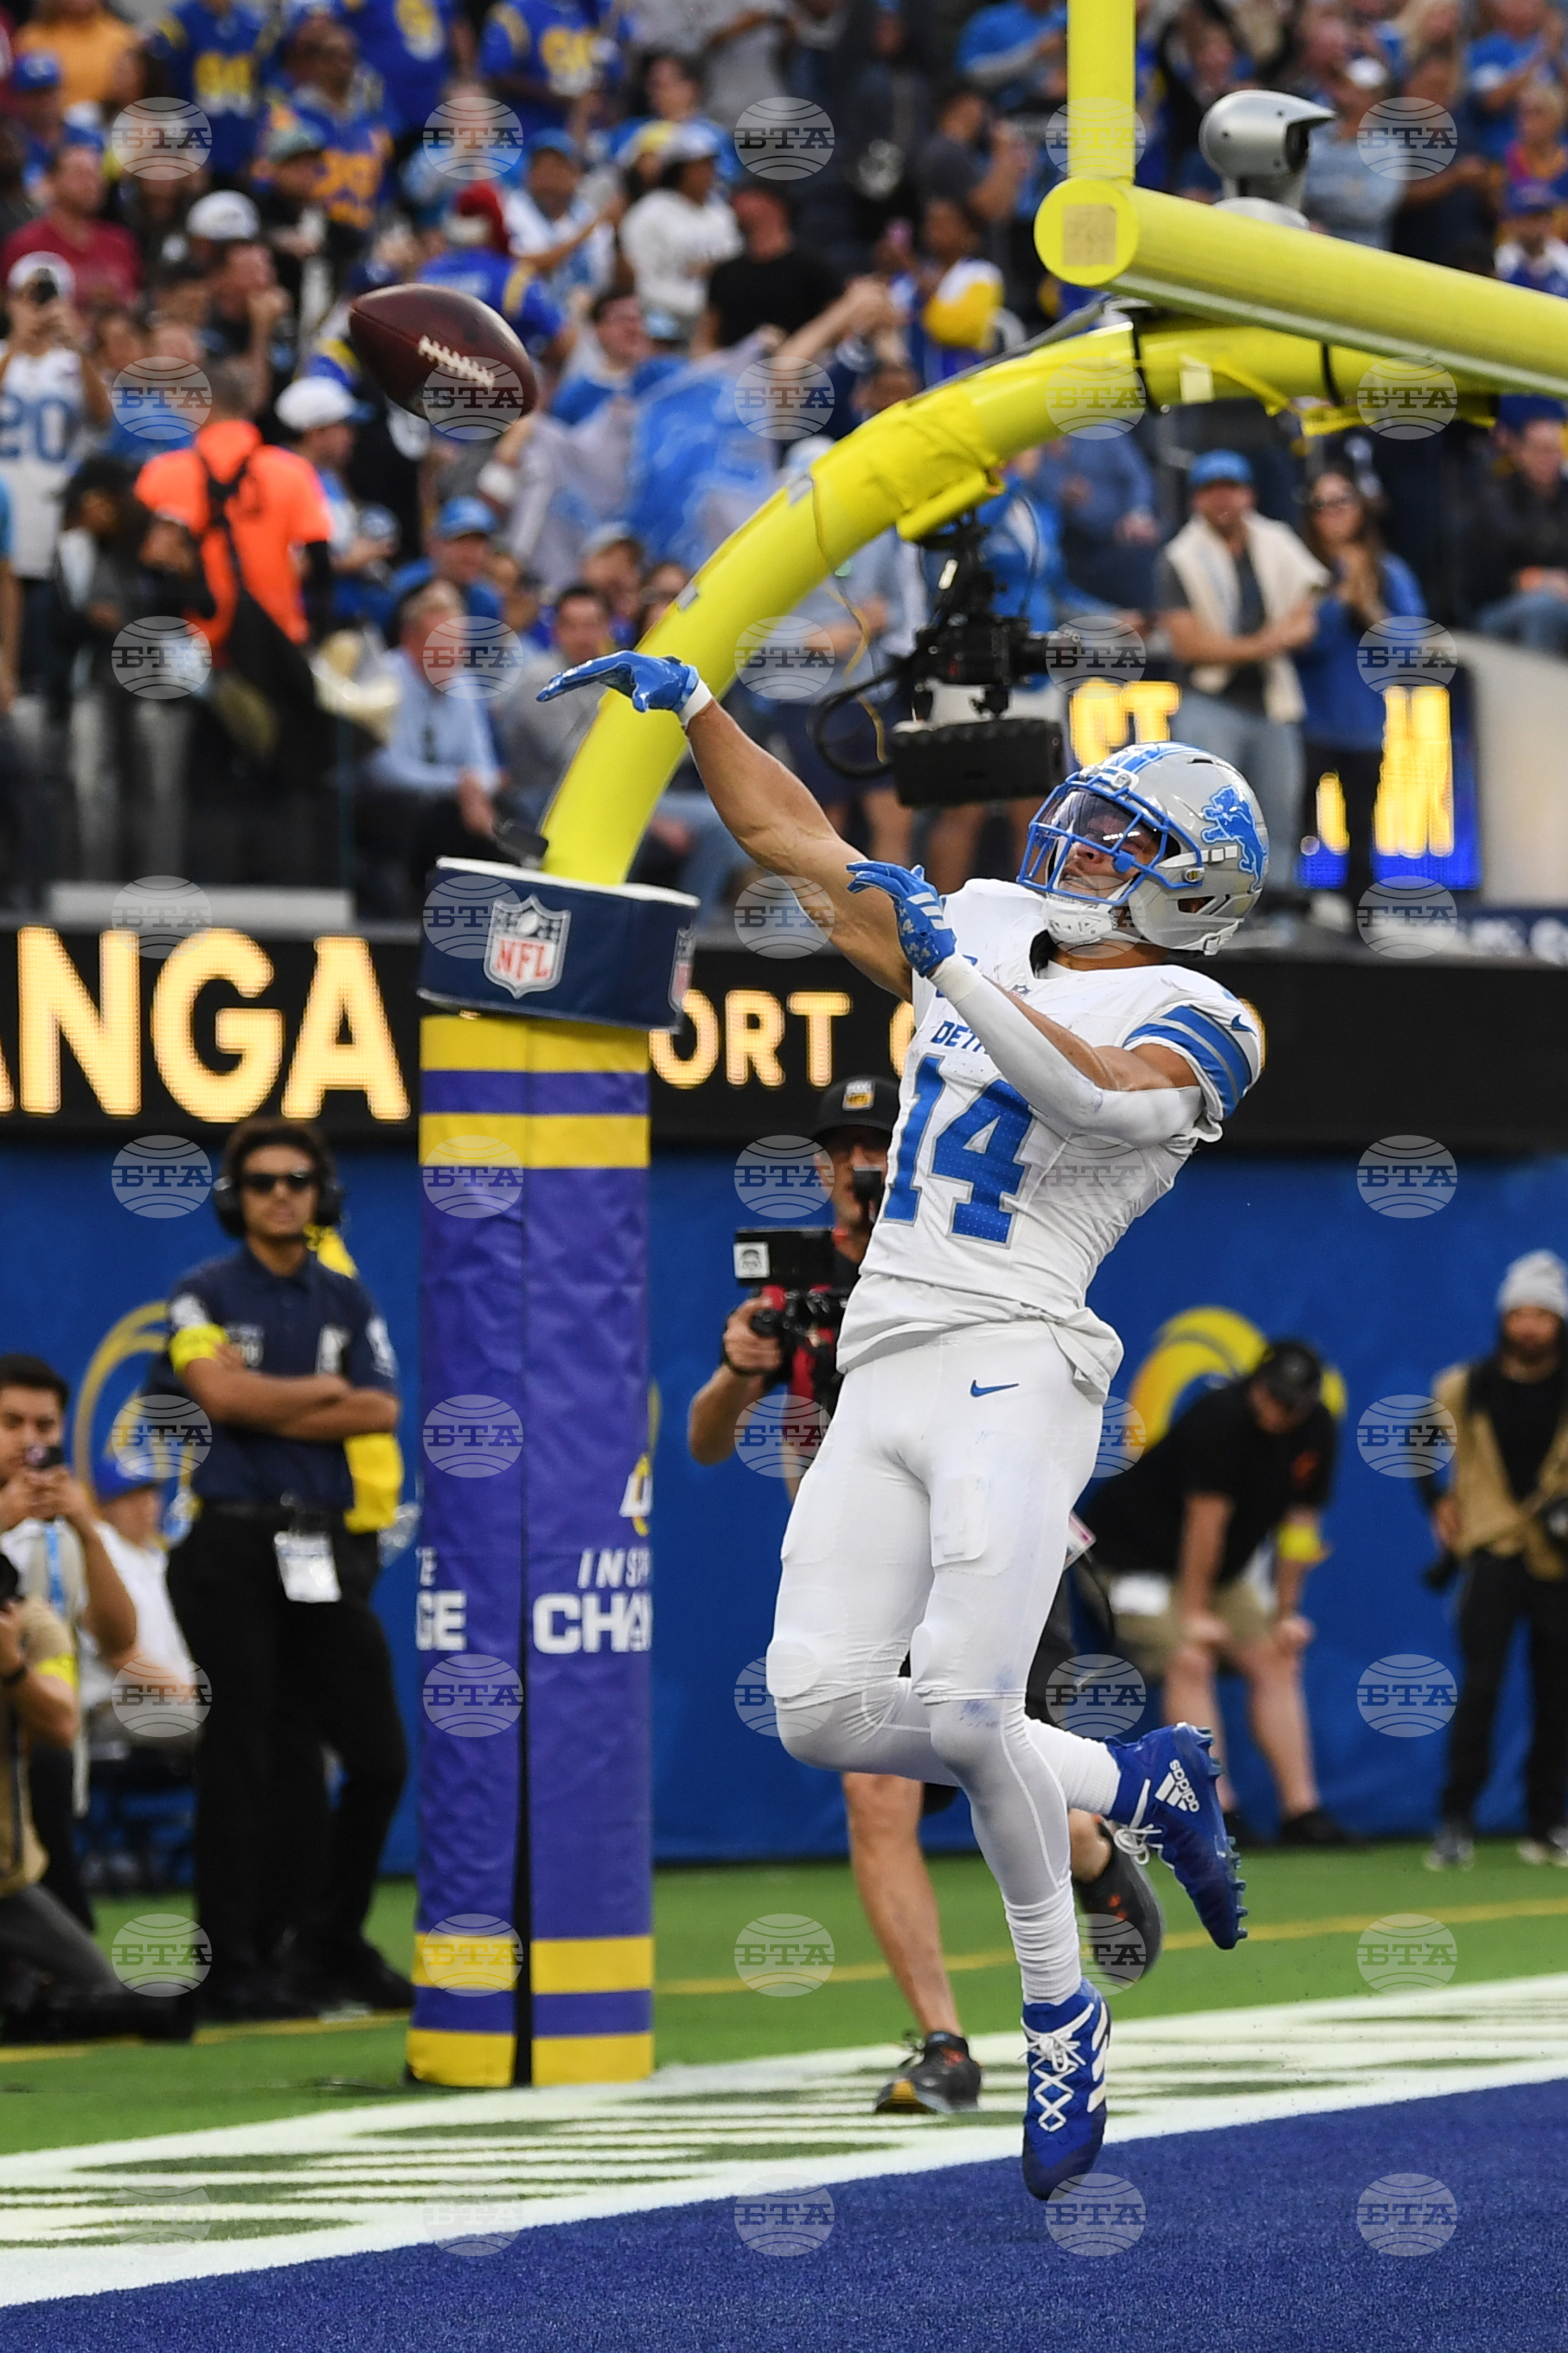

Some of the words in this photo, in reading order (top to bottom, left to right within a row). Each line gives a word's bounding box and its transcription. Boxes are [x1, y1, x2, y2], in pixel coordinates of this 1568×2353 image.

[496, 938, 552, 982] NFL
[0, 926, 412, 1123] NGA
[880, 1052, 1035, 1249] 14
[1169, 1760, 1200, 1812] adidas
